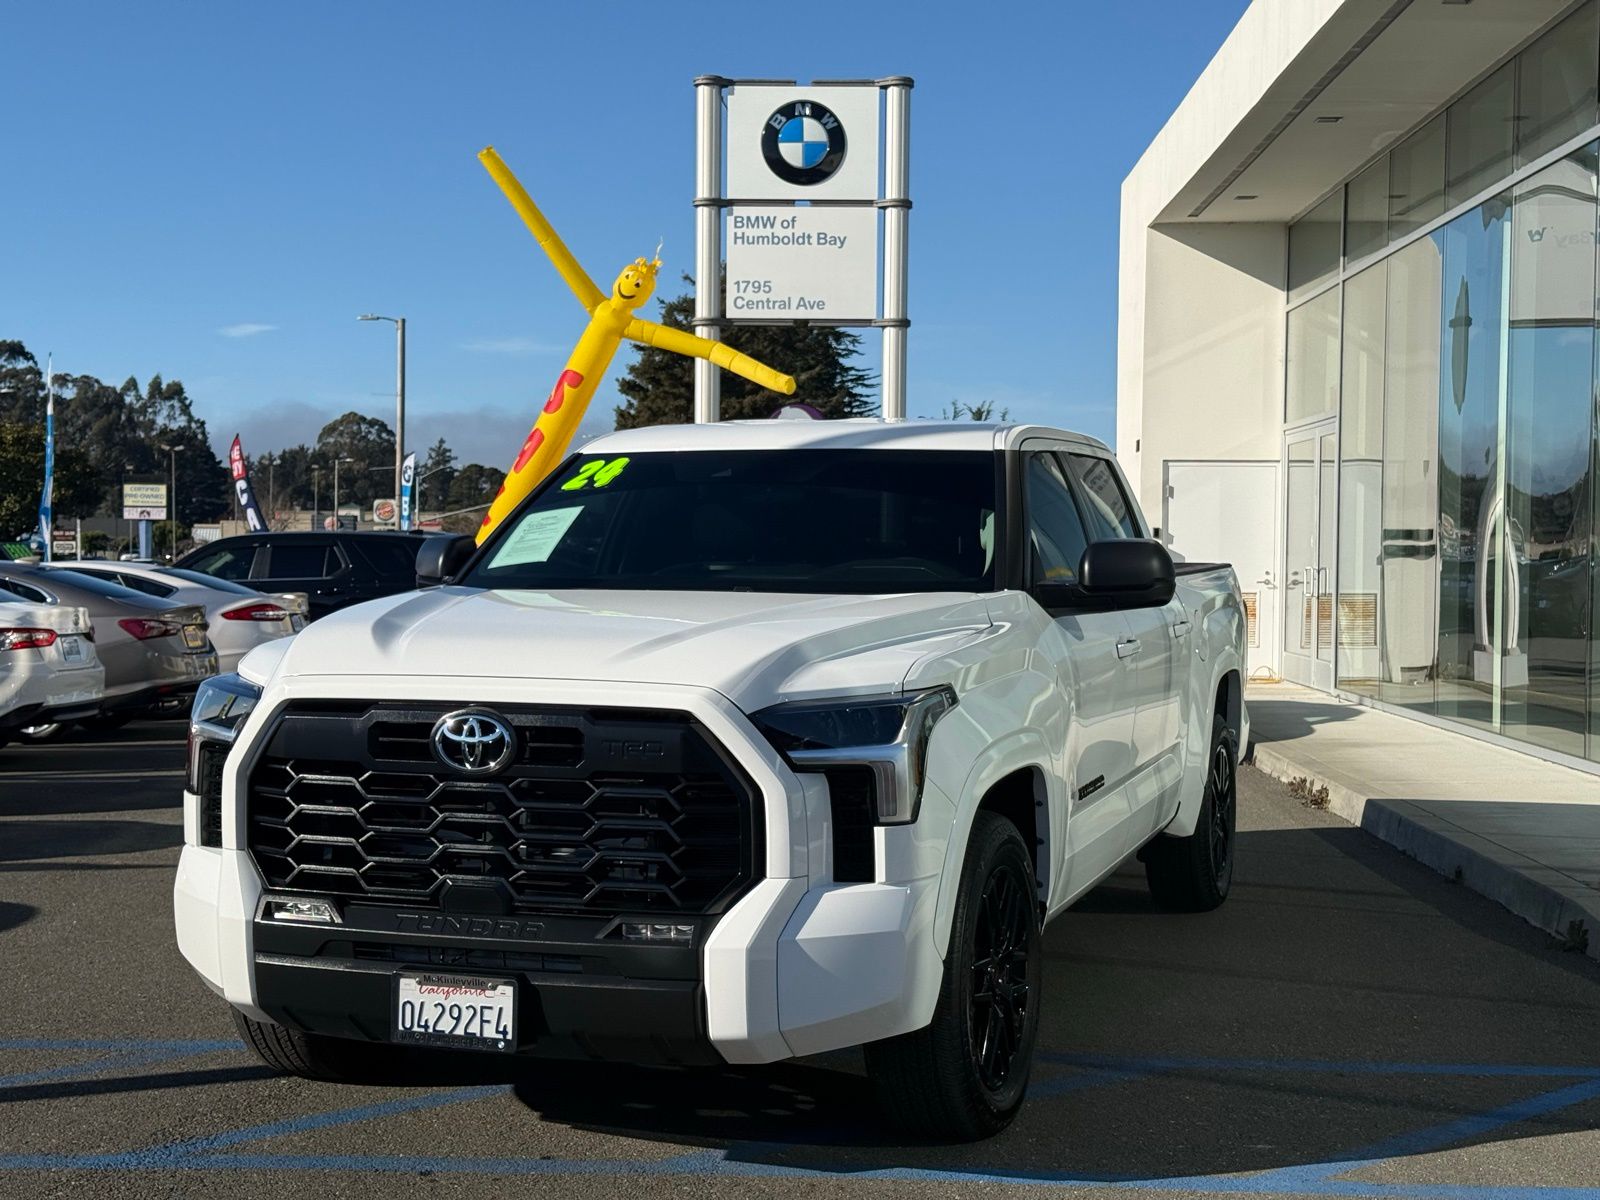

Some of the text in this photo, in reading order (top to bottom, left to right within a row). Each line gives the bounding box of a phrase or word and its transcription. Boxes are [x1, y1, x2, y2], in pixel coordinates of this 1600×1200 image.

[769, 103, 838, 130] BMW
[733, 215, 797, 230] BMW of
[733, 232, 847, 249] Humboldt Bay
[733, 280, 772, 294] 1795
[733, 297, 826, 311] Central Ave
[561, 457, 630, 491] 24
[396, 914, 545, 938] TUNDRA
[423, 974, 486, 988] McKinleyville
[401, 1000, 509, 1040] 04292F4
